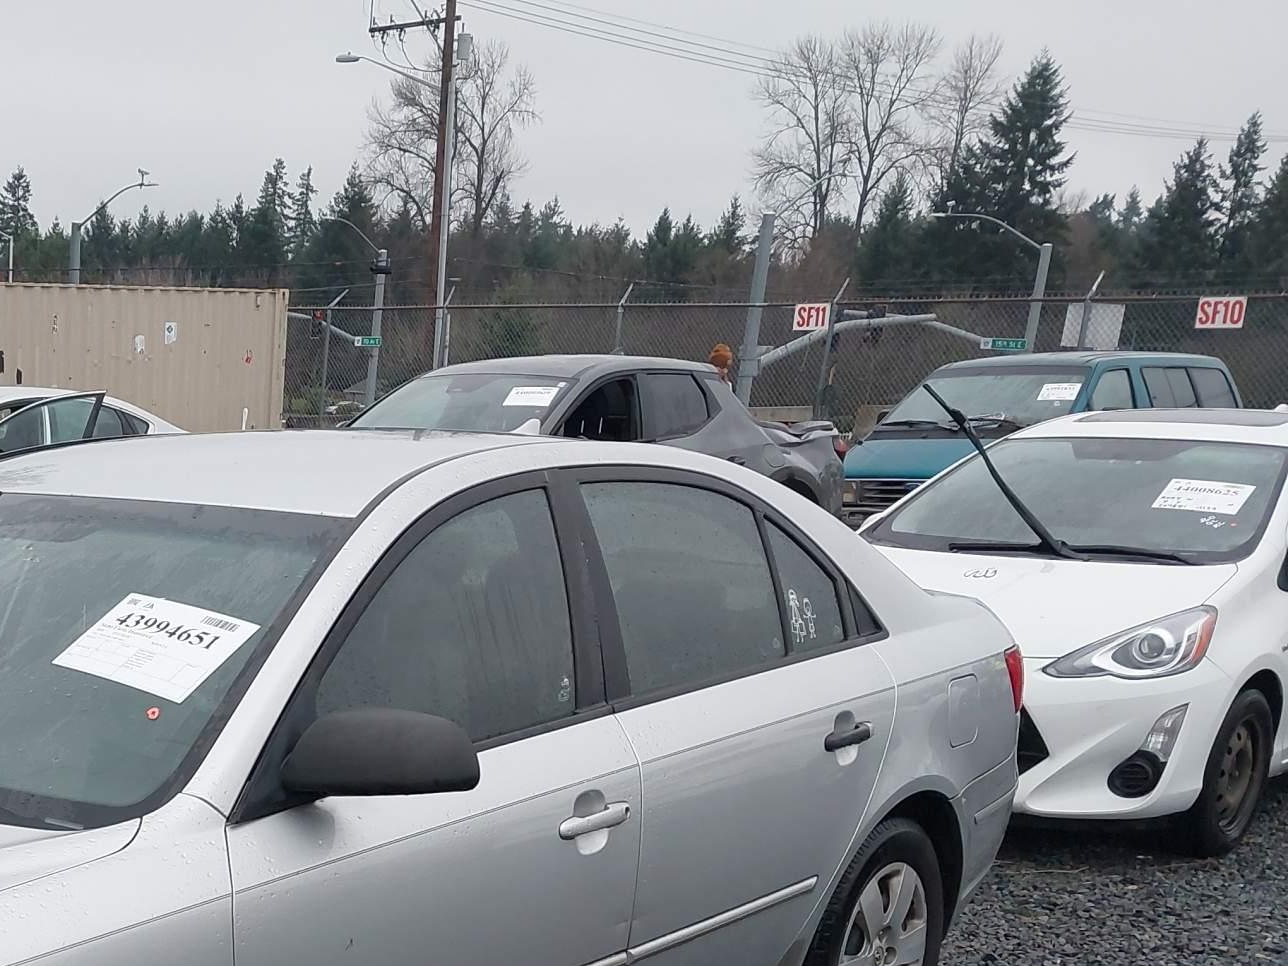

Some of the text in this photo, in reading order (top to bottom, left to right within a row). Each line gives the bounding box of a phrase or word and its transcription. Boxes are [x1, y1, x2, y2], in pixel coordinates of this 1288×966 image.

[797, 306, 827, 328] SF11
[1198, 300, 1244, 325] SF10
[116, 612, 221, 650] 43994651
